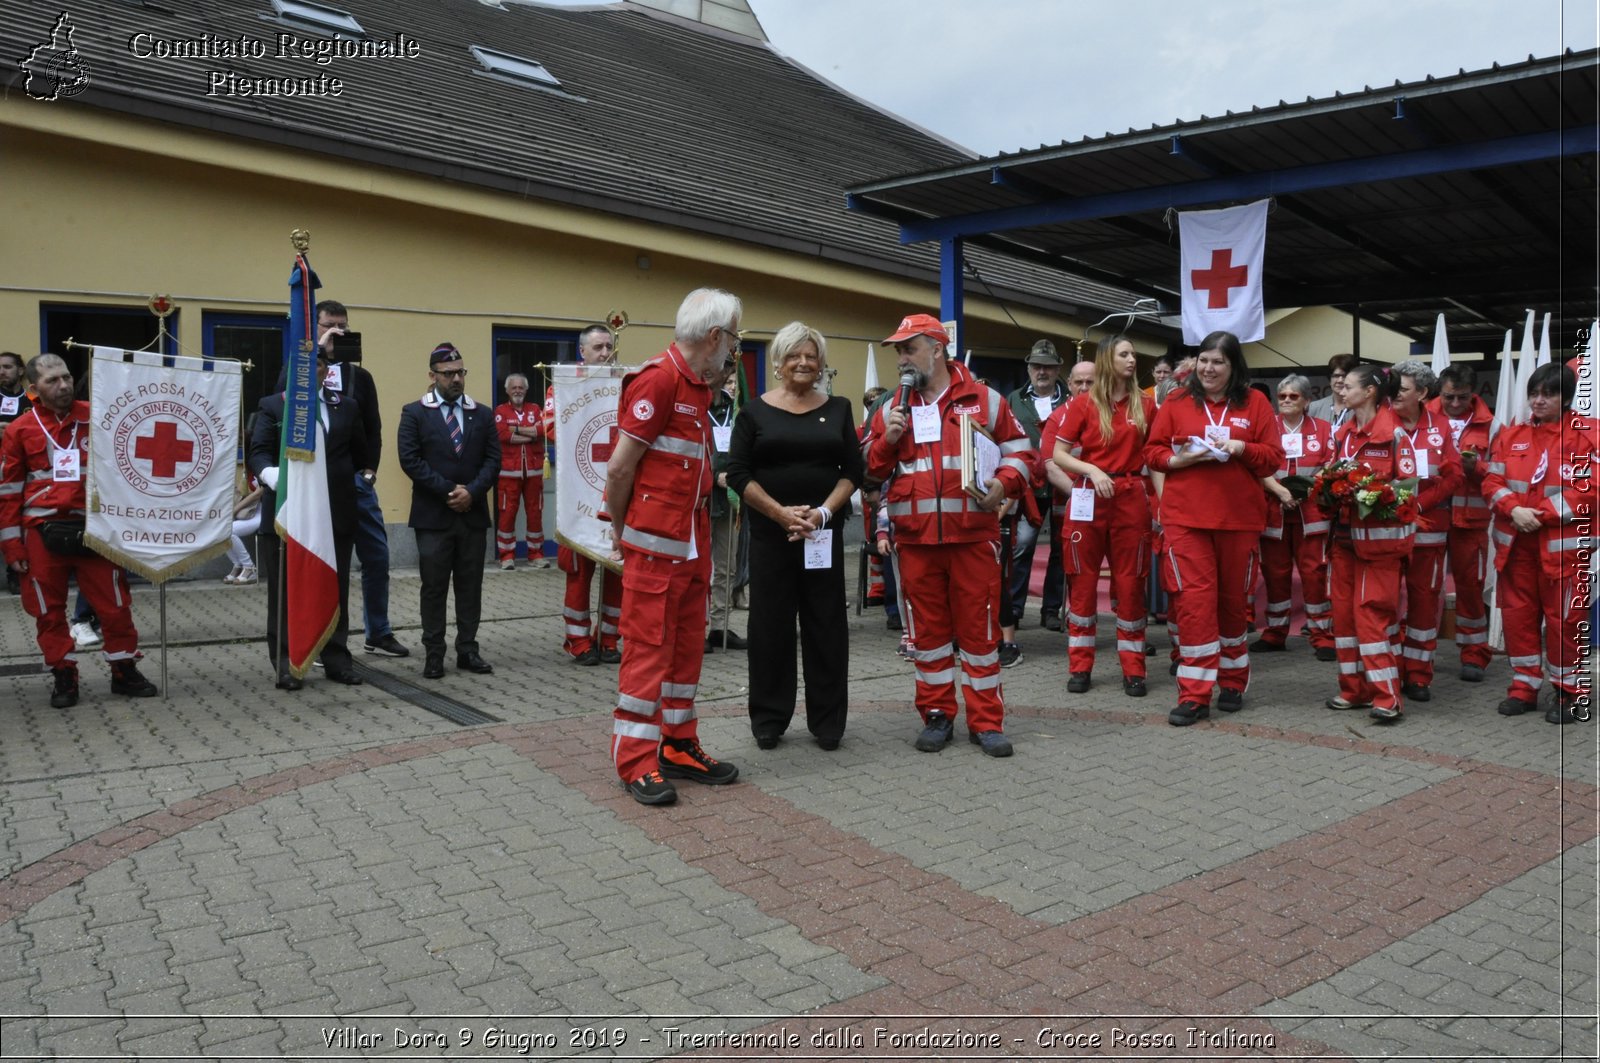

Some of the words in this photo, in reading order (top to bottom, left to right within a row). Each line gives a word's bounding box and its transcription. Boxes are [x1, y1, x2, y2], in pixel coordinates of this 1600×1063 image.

[296, 391, 309, 401] DI
[100, 391, 136, 431] CROCE
[138, 382, 186, 398] ROSSA
[190, 391, 230, 442] ITALIANA
[142, 403, 189, 419] GINEVRA
[560, 392, 593, 425] CROCE
[593, 386, 621, 400] ROS
[128, 411, 142, 423] DI
[190, 417, 204, 430] 22
[293, 404, 309, 444] SEZIONE
[116, 421, 149, 491] CONVENZIONE
[197, 433, 212, 475] AGOSTO
[577, 425, 598, 485] CONVENZIONE
[593, 419, 602, 429] DI
[176, 476, 198, 492] 1864
[99, 503, 204, 521] DELEGAZIONE
[208, 508, 222, 520] DI
[121, 530, 197, 545] GIAVENO
